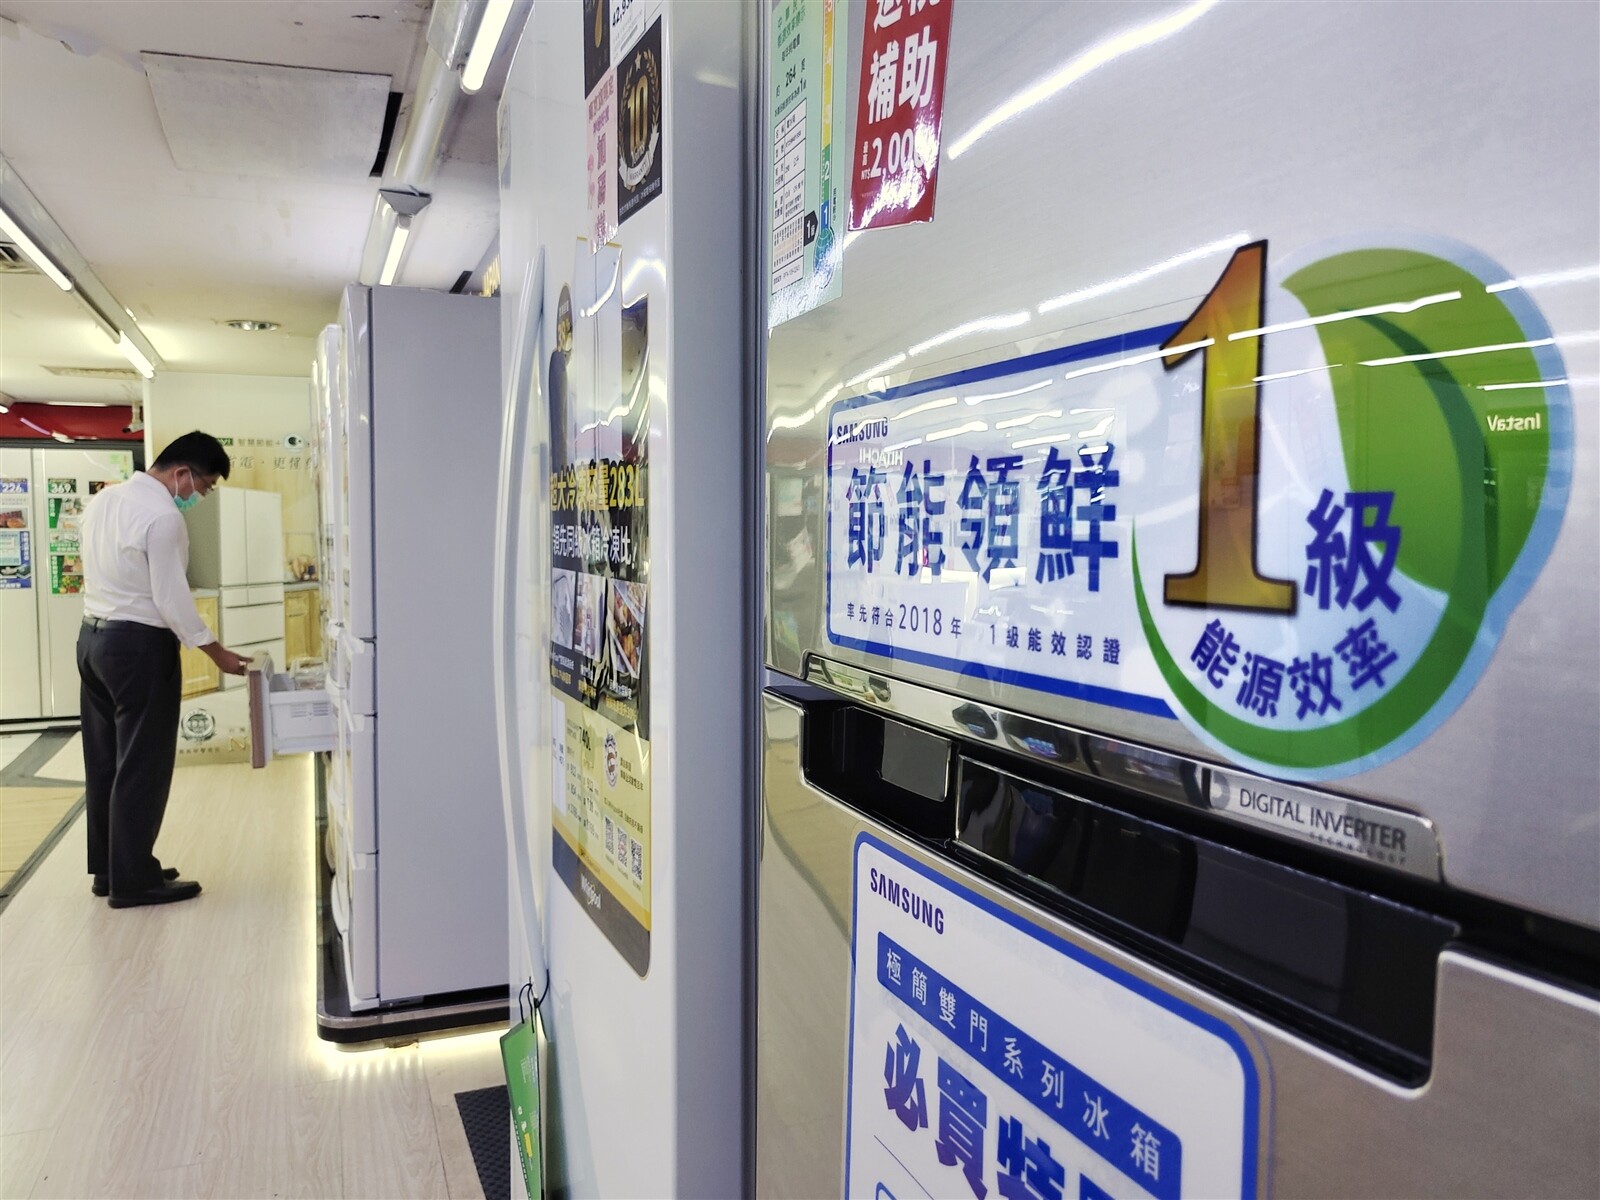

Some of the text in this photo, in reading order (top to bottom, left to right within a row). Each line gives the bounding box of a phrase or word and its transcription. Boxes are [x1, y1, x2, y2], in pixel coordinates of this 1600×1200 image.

[867, 25, 938, 124] 補助
[628, 75, 648, 152] 10
[836, 416, 888, 445] SAMSUNG
[845, 442, 1120, 593] 節能領鮮
[989, 624, 1121, 665] 1級能效認證
[1190, 617, 1398, 720] 能源效率
[1239, 788, 1407, 851] DIGITAL INVERTER
[869, 867, 945, 935] SAMSUNG
[886, 947, 1160, 1182] 極簡雙門系列冰箱
